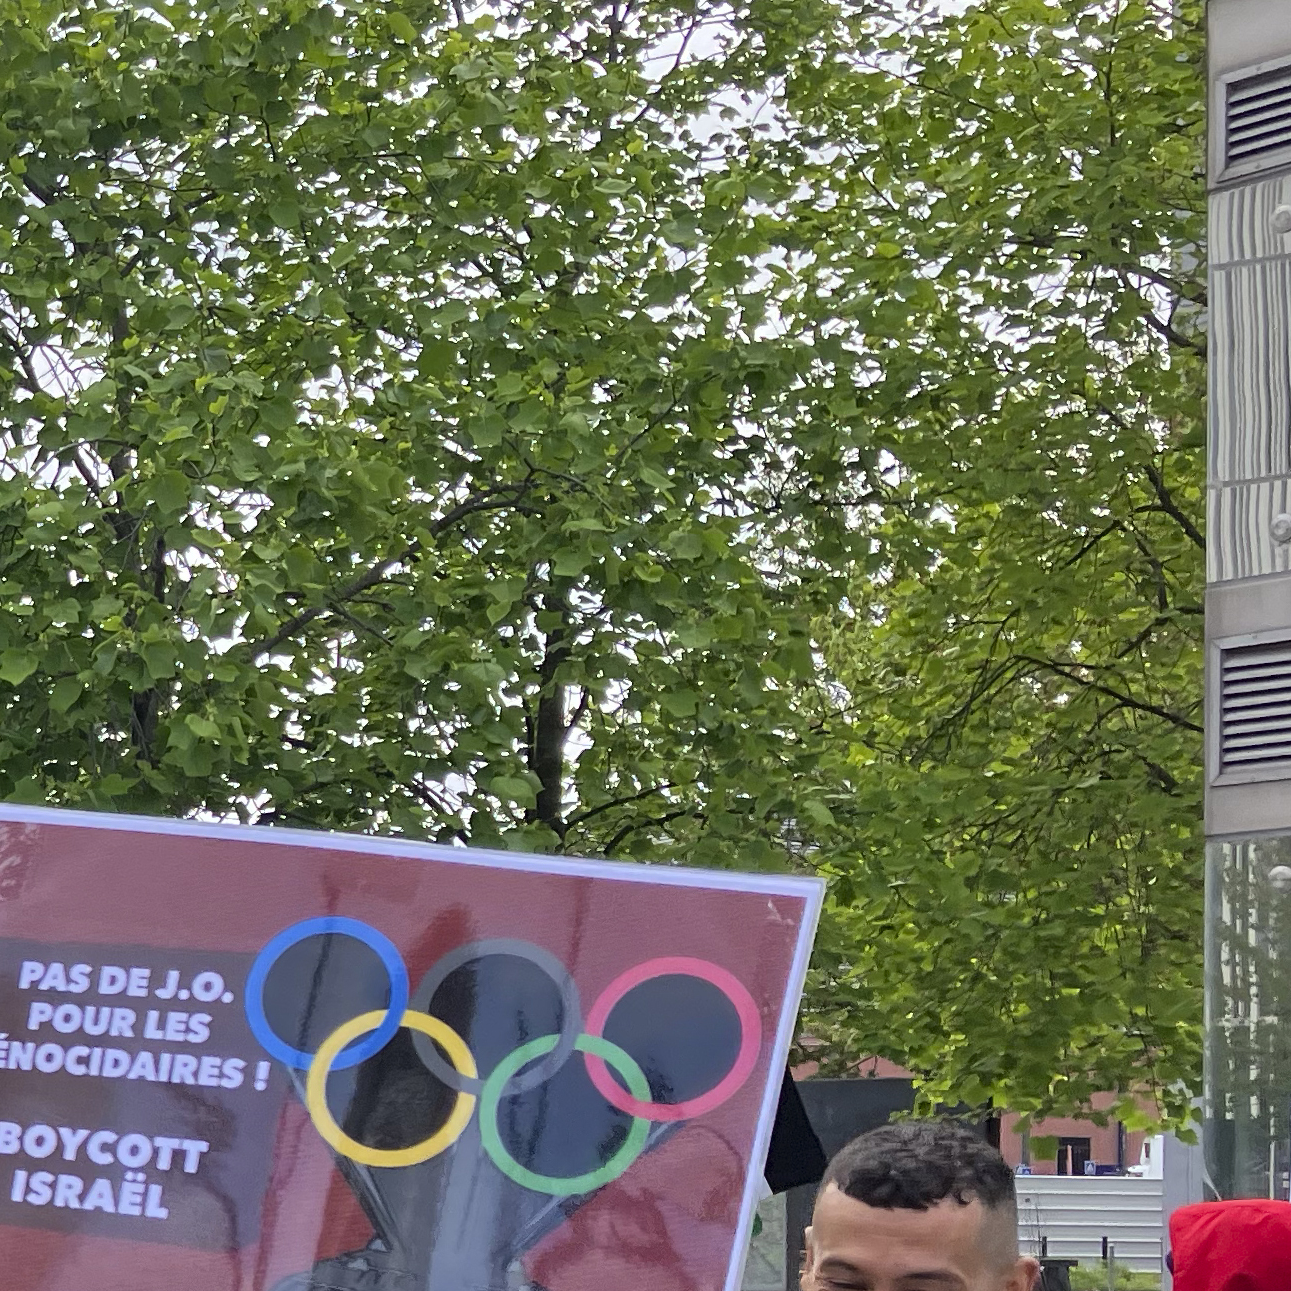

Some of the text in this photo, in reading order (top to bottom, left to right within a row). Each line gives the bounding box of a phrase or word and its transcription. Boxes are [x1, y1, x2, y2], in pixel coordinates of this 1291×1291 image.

[18, 959, 235, 1005] PAS DE J.O.
[27, 1001, 213, 1044] POUR LES
[10, 1168, 170, 1220] ISRAËL
